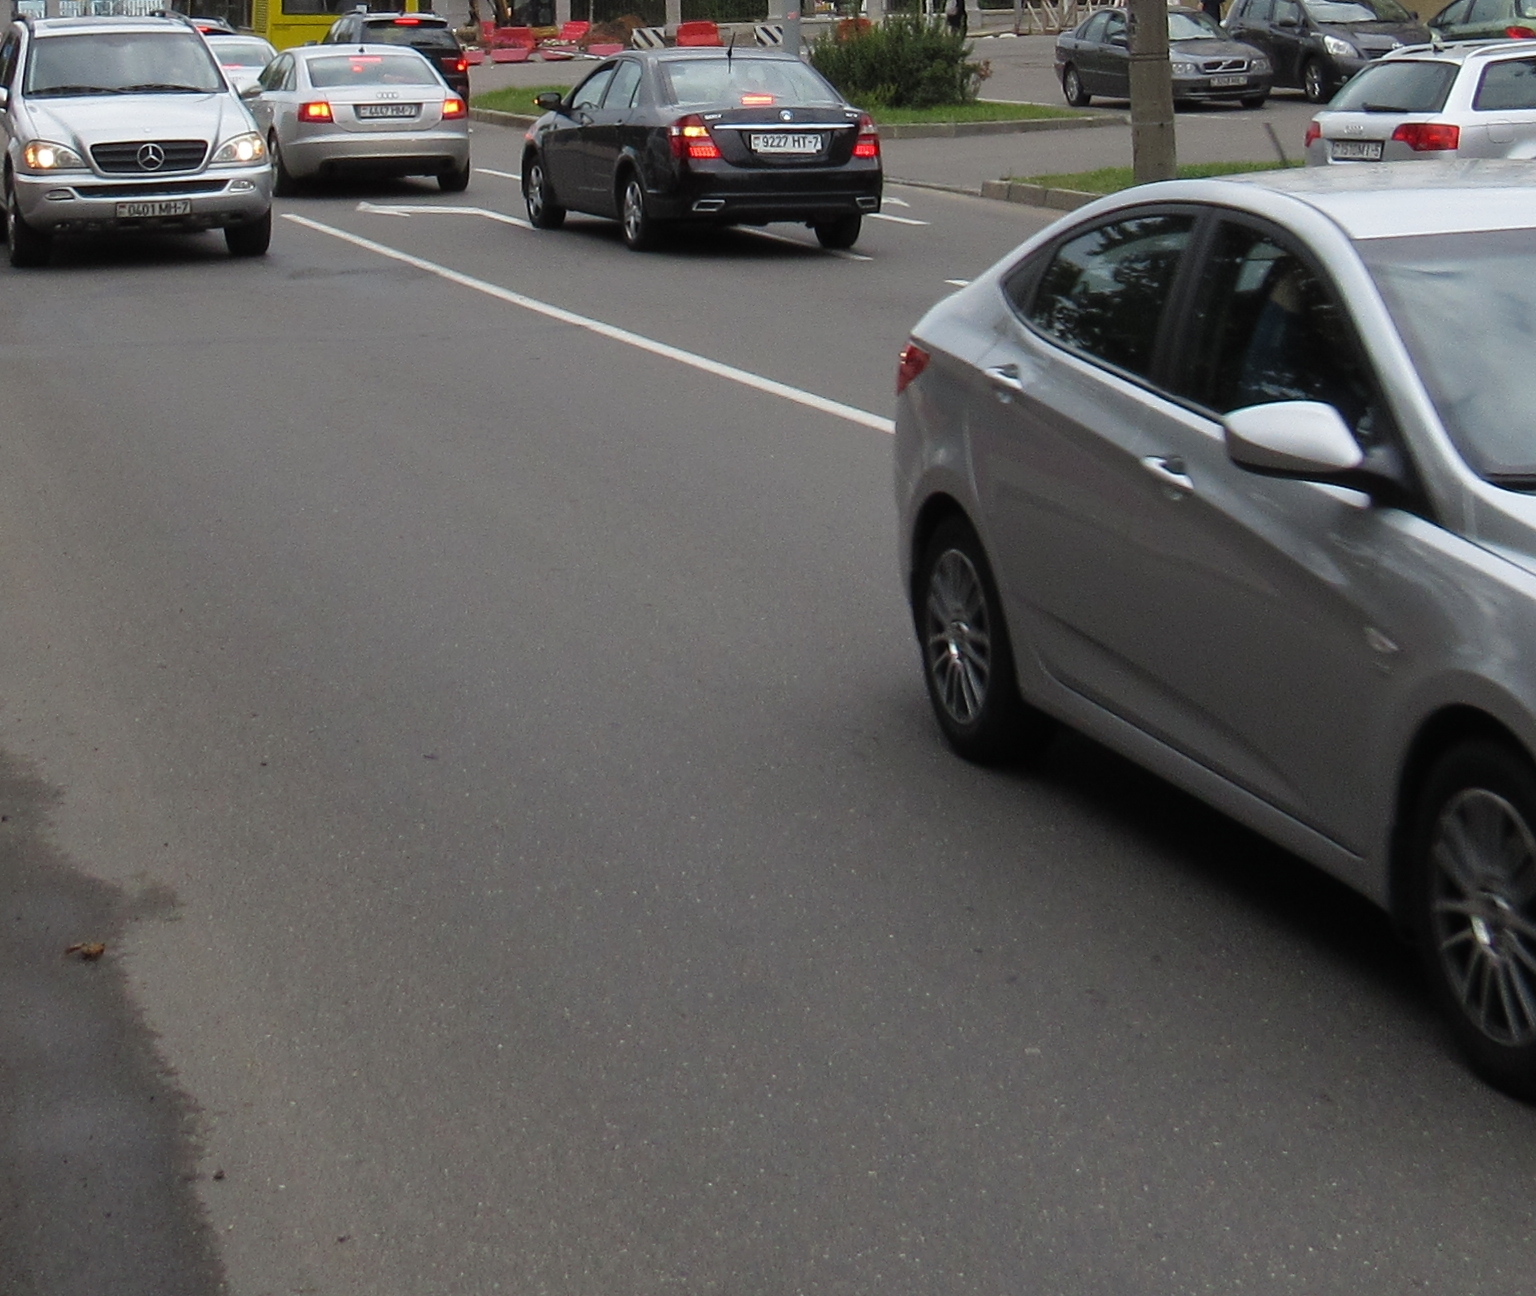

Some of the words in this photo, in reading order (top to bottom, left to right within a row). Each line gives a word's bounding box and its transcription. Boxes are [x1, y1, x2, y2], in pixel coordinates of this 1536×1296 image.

[763, 134, 788, 147] 9227
[792, 135, 819, 148] HT-7
[128, 204, 156, 217] 0401
